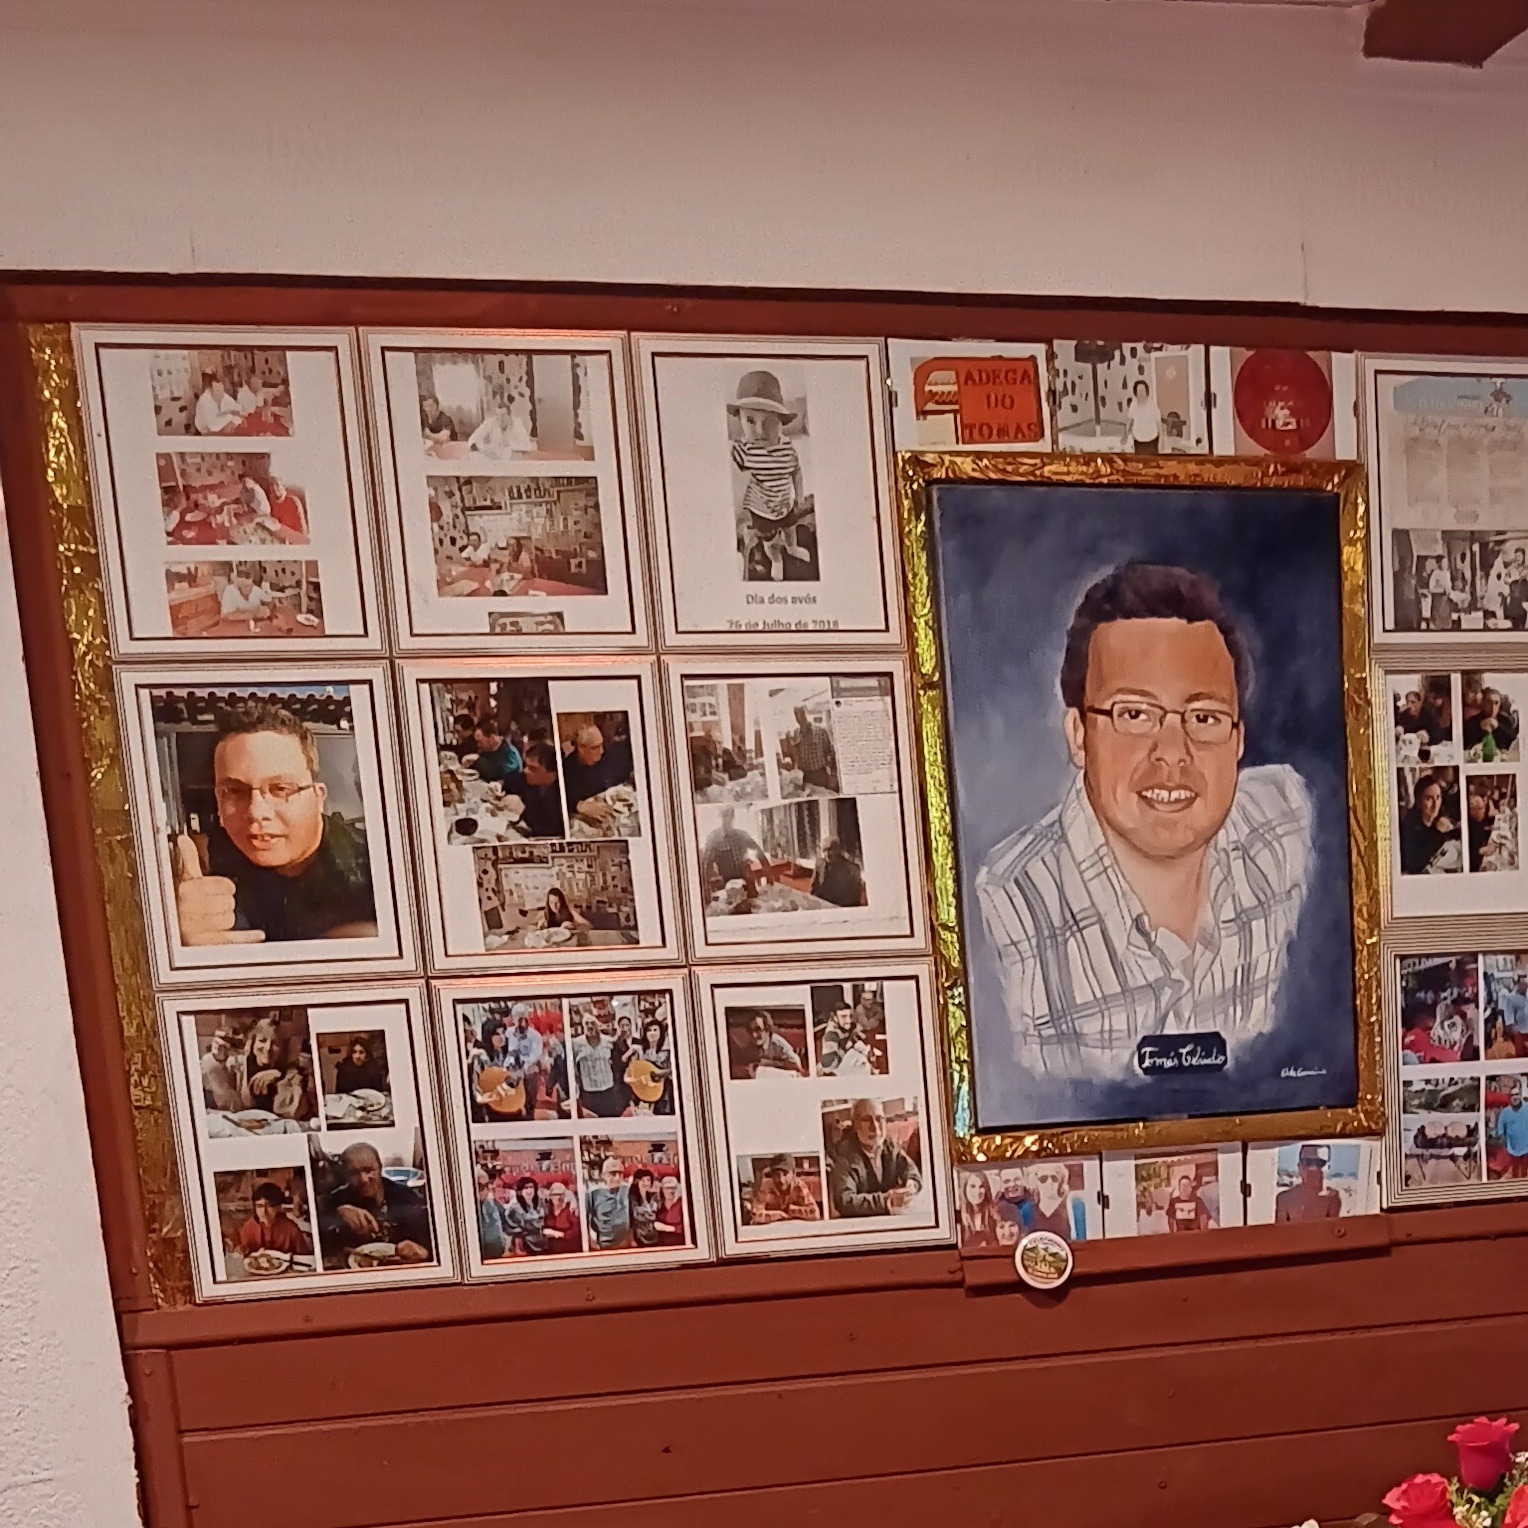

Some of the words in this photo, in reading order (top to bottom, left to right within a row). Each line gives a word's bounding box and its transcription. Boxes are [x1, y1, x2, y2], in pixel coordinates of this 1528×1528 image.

[746, 593, 765, 605] Dia
[768, 593, 788, 605] dos
[791, 592, 817, 605] avós
